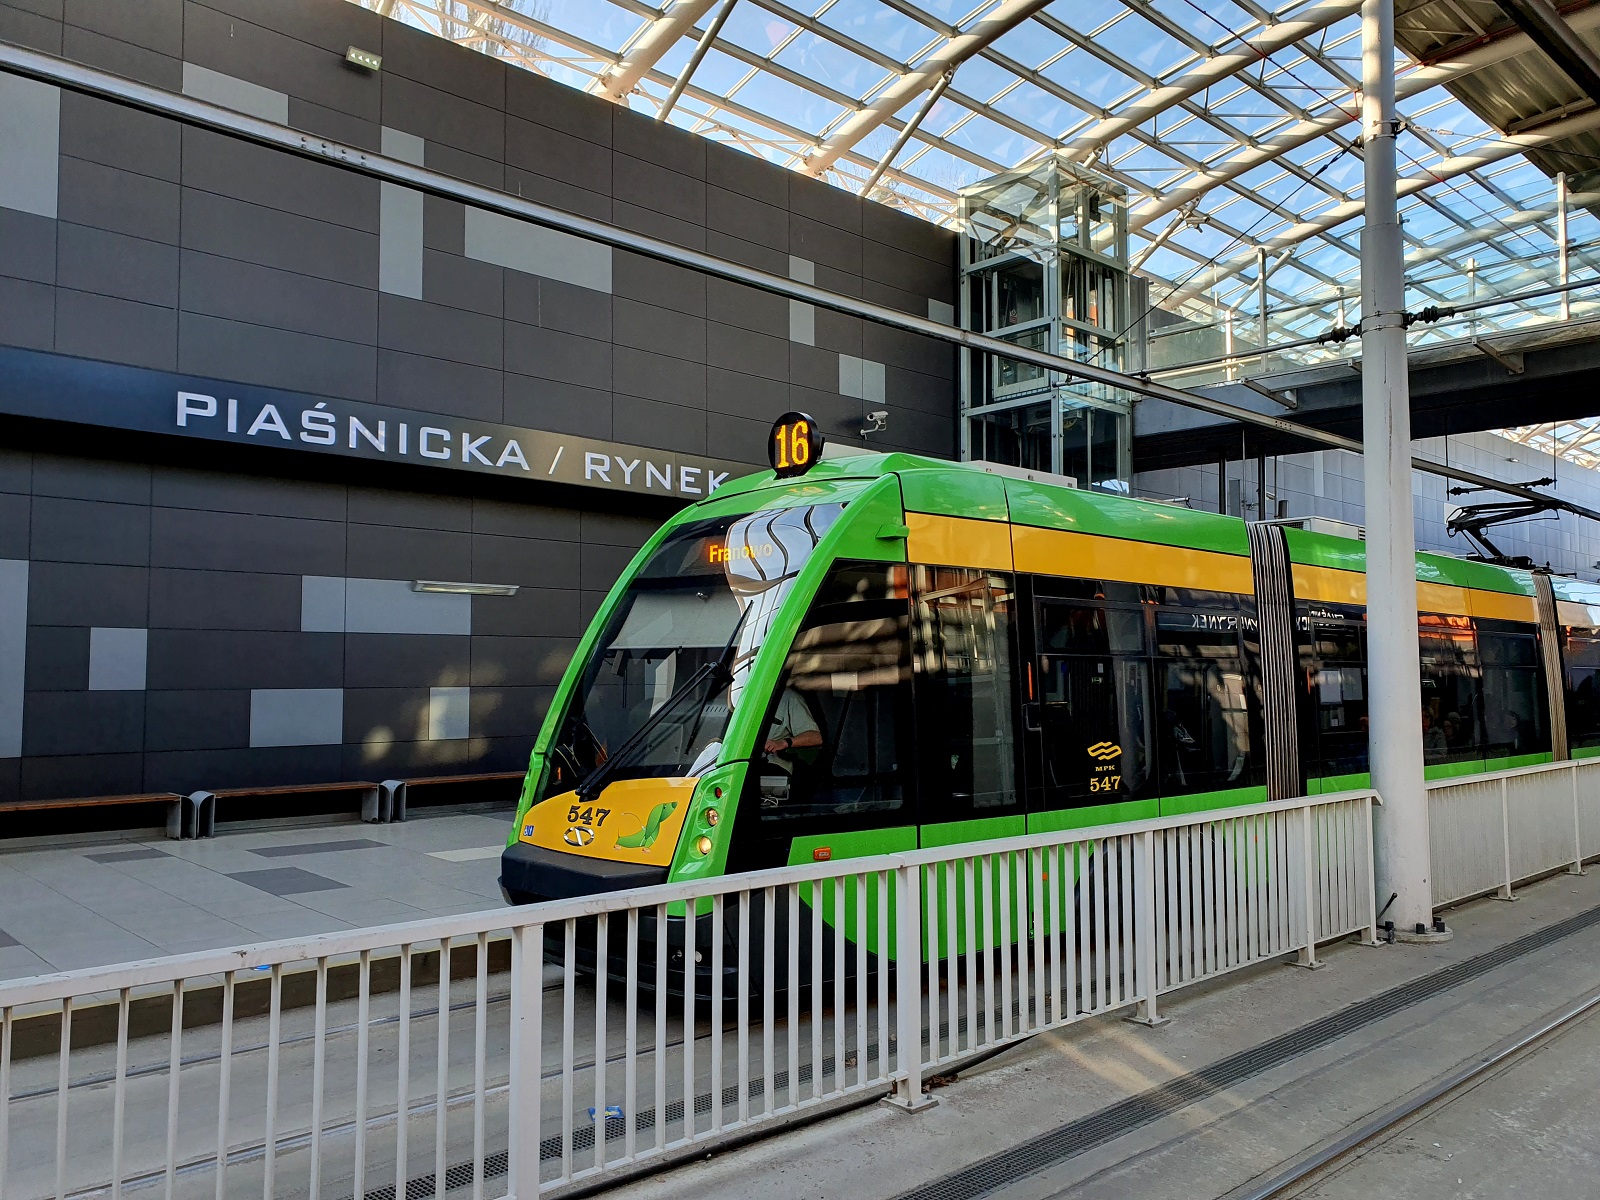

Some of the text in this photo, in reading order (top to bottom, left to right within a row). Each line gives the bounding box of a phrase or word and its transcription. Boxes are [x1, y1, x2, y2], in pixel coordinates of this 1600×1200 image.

[176, 389, 730, 495] PIAŚNICKA / RYNEK
[776, 420, 809, 468] 16
[709, 543, 773, 563] Franowo
[1094, 764, 1116, 772] MPK
[1089, 775, 1121, 792] 547
[566, 804, 611, 828] 547
